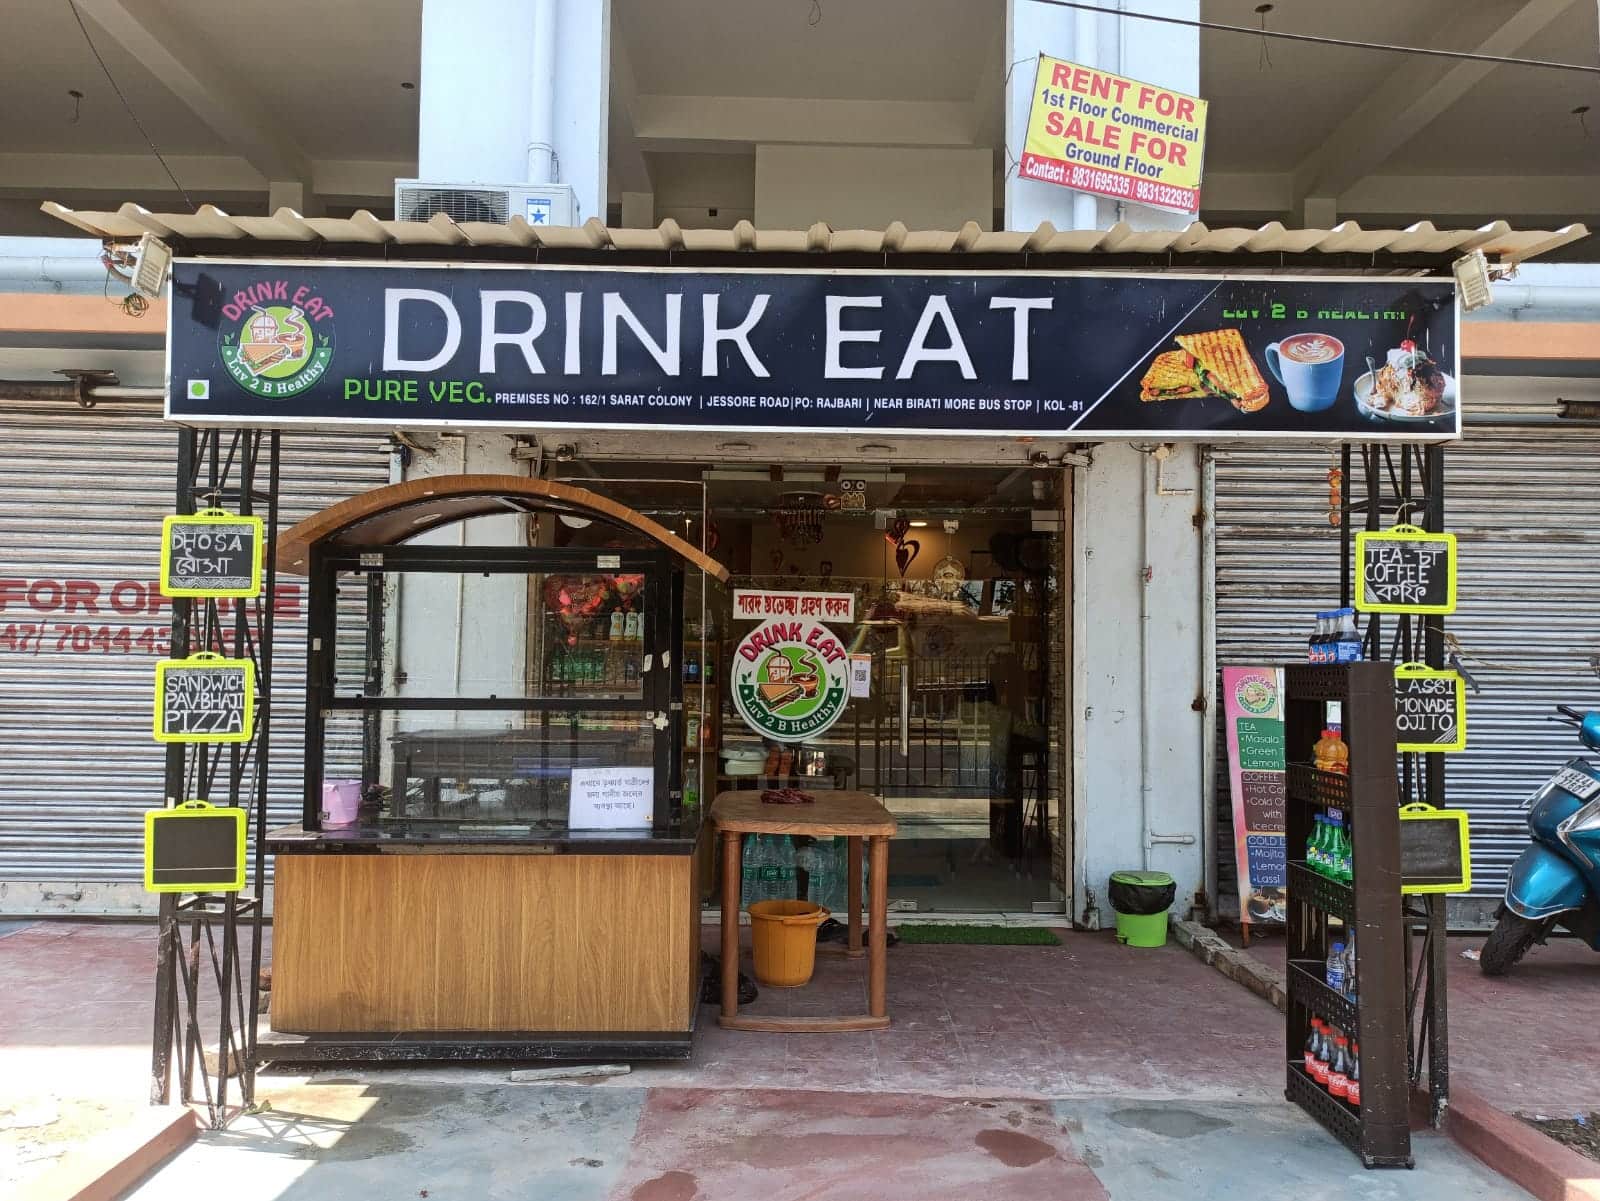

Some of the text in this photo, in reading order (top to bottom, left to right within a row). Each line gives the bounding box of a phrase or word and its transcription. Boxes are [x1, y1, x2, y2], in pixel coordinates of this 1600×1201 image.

[1051, 63, 1195, 122] RENT FOR
[1042, 88, 1198, 142] 1st Floor Commercial
[1045, 112, 1188, 166] SALE FOR
[1066, 143, 1163, 178] Ground Floor
[222, 280, 334, 322] DRINK EAT
[383, 288, 1053, 380] DRINK EAT
[228, 358, 324, 394] Luv 2 B Healthy
[344, 379, 492, 404] PURE VEG.
[495, 393, 550, 406] PREMISES
[554, 393, 569, 406] NO
[580, 394, 606, 407] 162/1
[610, 394, 644, 407] SARAT
[648, 394, 692, 408] COLONY
[707, 395, 790, 409] JESSORE ROAD
[816, 397, 862, 410] RAJBARI
[874, 397, 1032, 412] NEAR BIRATI MORE BUS STOP
[1044, 400, 1066, 413] KOL
[172, 532, 242, 552] DHOSA
[1414, 550, 1443, 566] চা
[1365, 563, 1431, 584] COFFEE
[0, 579, 99, 614] FOR
[738, 595, 850, 616] শারদ শুভেচ্ছা গ্রহণ করুন
[739, 622, 846, 664] DRINK EAT
[166, 675, 245, 692] SANDWICH
[1395, 698, 1455, 713] MONADE
[165, 709, 243, 733] PIZZA
[744, 698, 838, 732] Luv 2 B Healthy
[1396, 714, 1453, 731] OJITO
[1240, 723, 1256, 731] TEA
[1245, 735, 1280, 744] Masala
[1246, 747, 1278, 756] Green
[1247, 759, 1280, 768] Lemon
[1243, 773, 1280, 781] COFFEE
[1250, 785, 1267, 794] Hot
[1250, 797, 1273, 806] Cold
[1263, 810, 1281, 818] with
[1248, 836, 1277, 845] COLD
[1254, 849, 1285, 860] Mojito
[1257, 874, 1280, 884] Lassi
